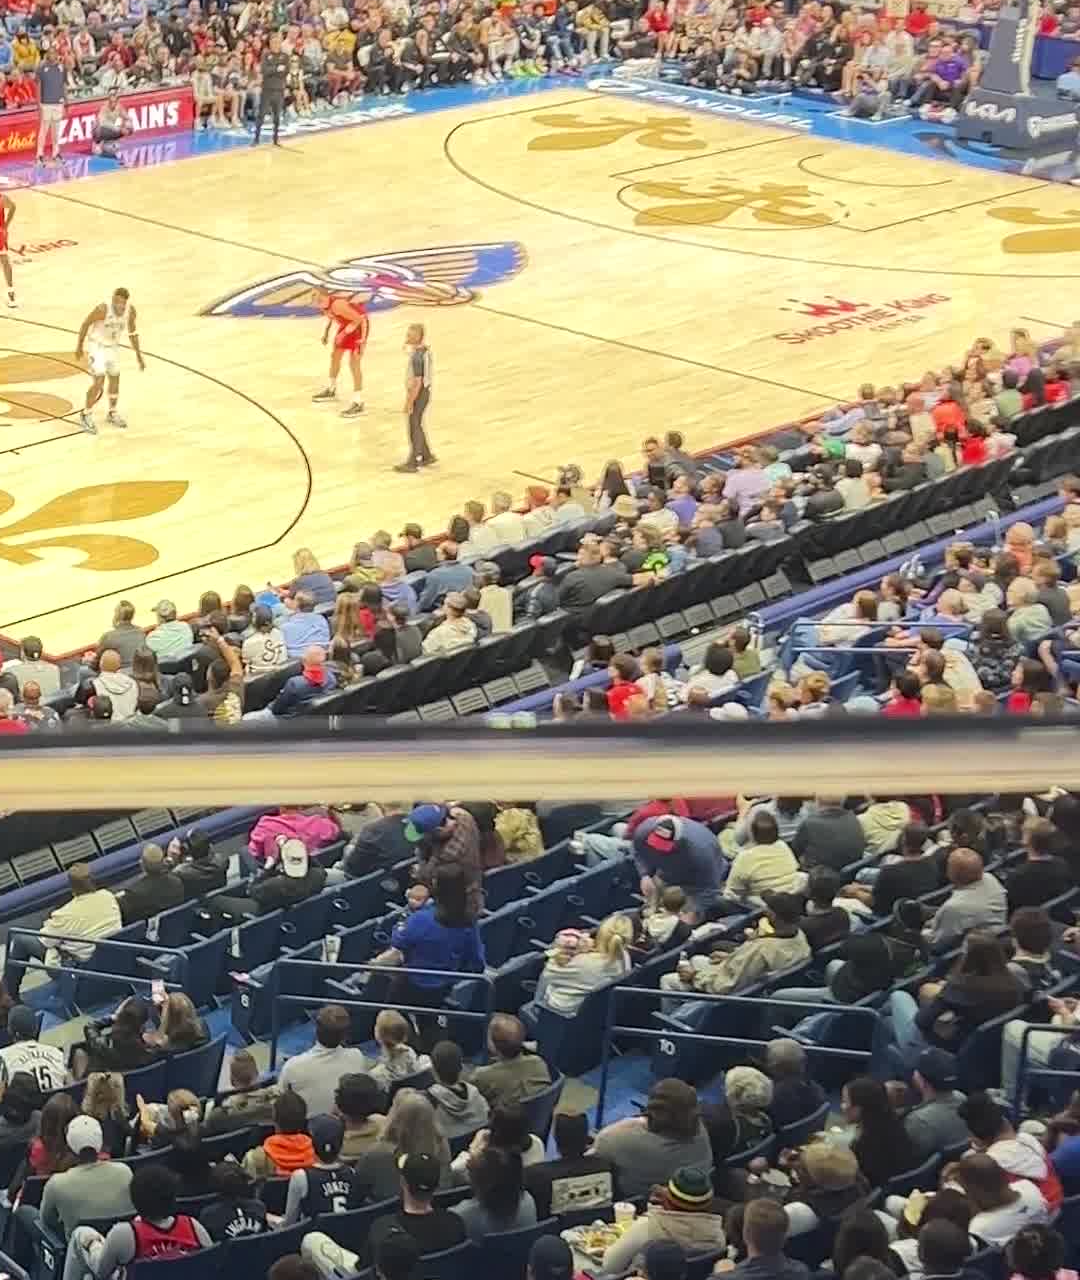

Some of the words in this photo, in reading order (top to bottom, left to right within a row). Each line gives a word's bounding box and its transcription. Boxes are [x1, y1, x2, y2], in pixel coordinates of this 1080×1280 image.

[58, 100, 182, 145] ZATAIN'S
[641, 89, 814, 129] FANDUEL
[773, 308, 898, 345] SMOOTHIE
[322, 1181, 352, 1197] JONES
